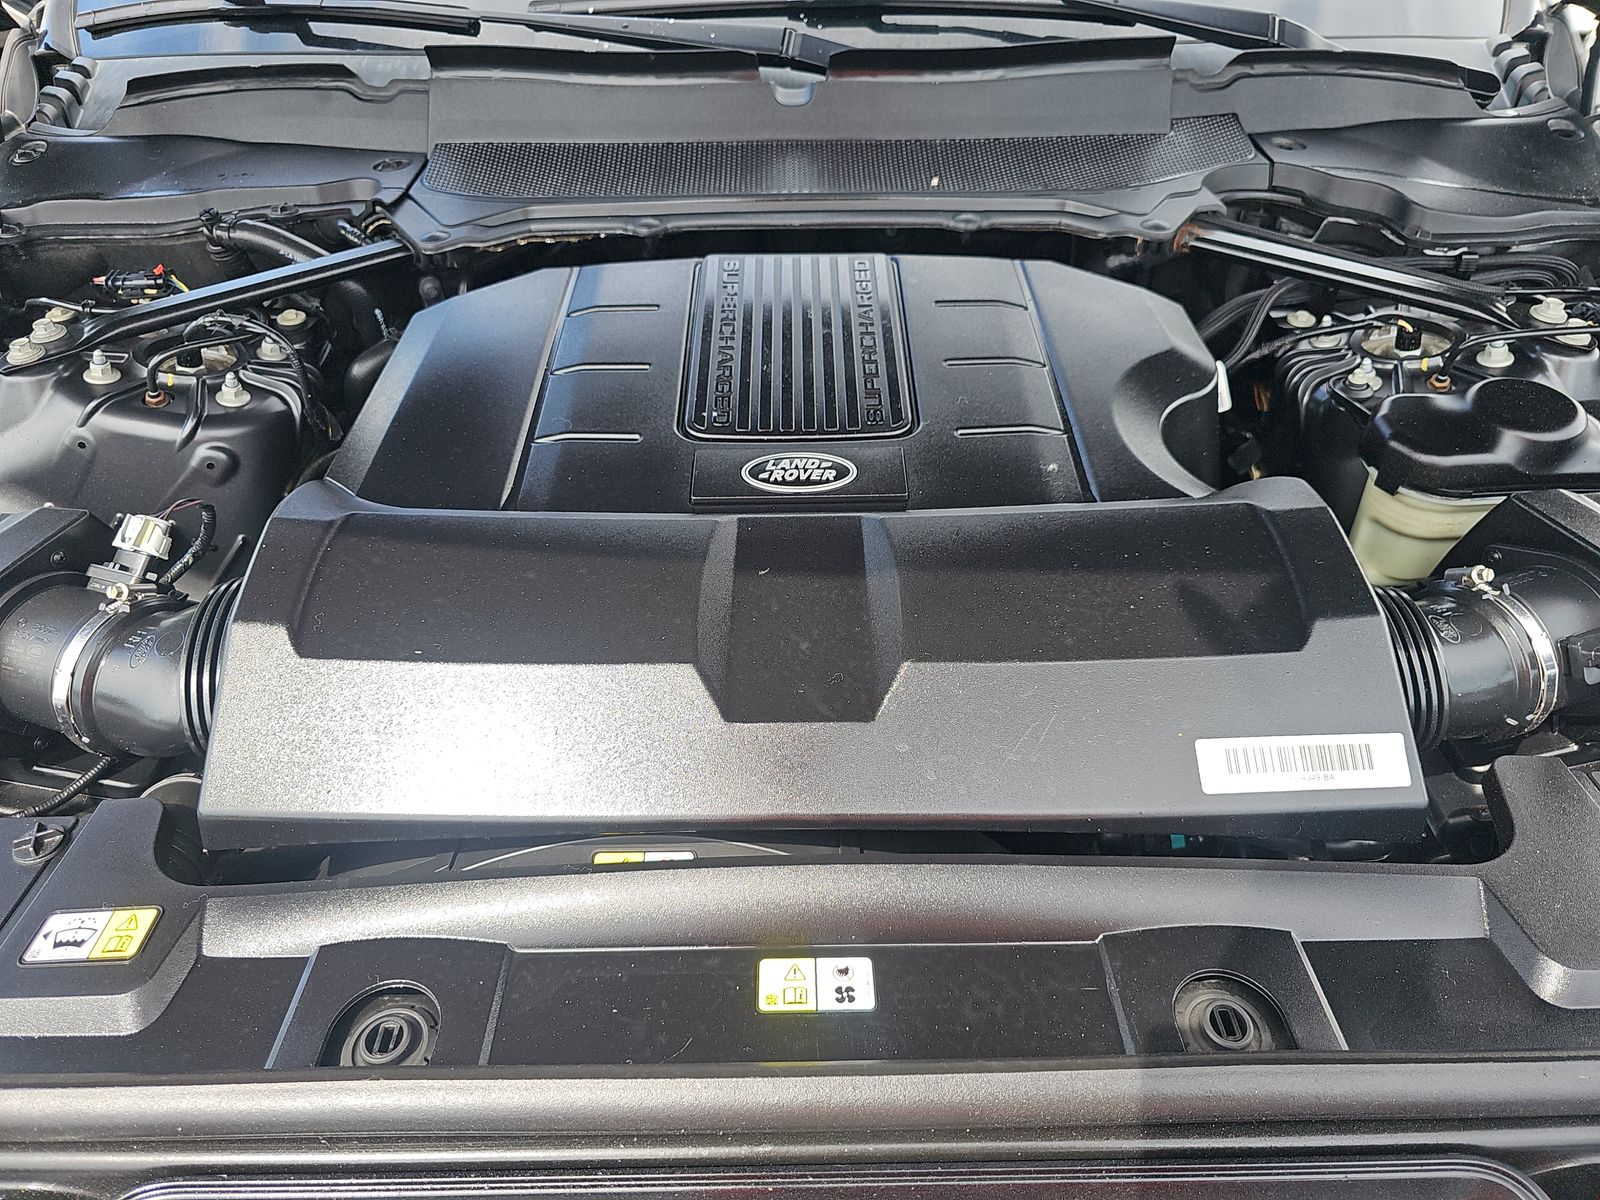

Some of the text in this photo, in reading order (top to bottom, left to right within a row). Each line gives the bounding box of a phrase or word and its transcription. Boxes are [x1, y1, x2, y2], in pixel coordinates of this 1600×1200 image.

[711, 259, 740, 427] SUPERCHARGED
[854, 259, 885, 426] SUPERCHARGED
[765, 458, 820, 471] LAND
[769, 468, 837, 483] ROVER
